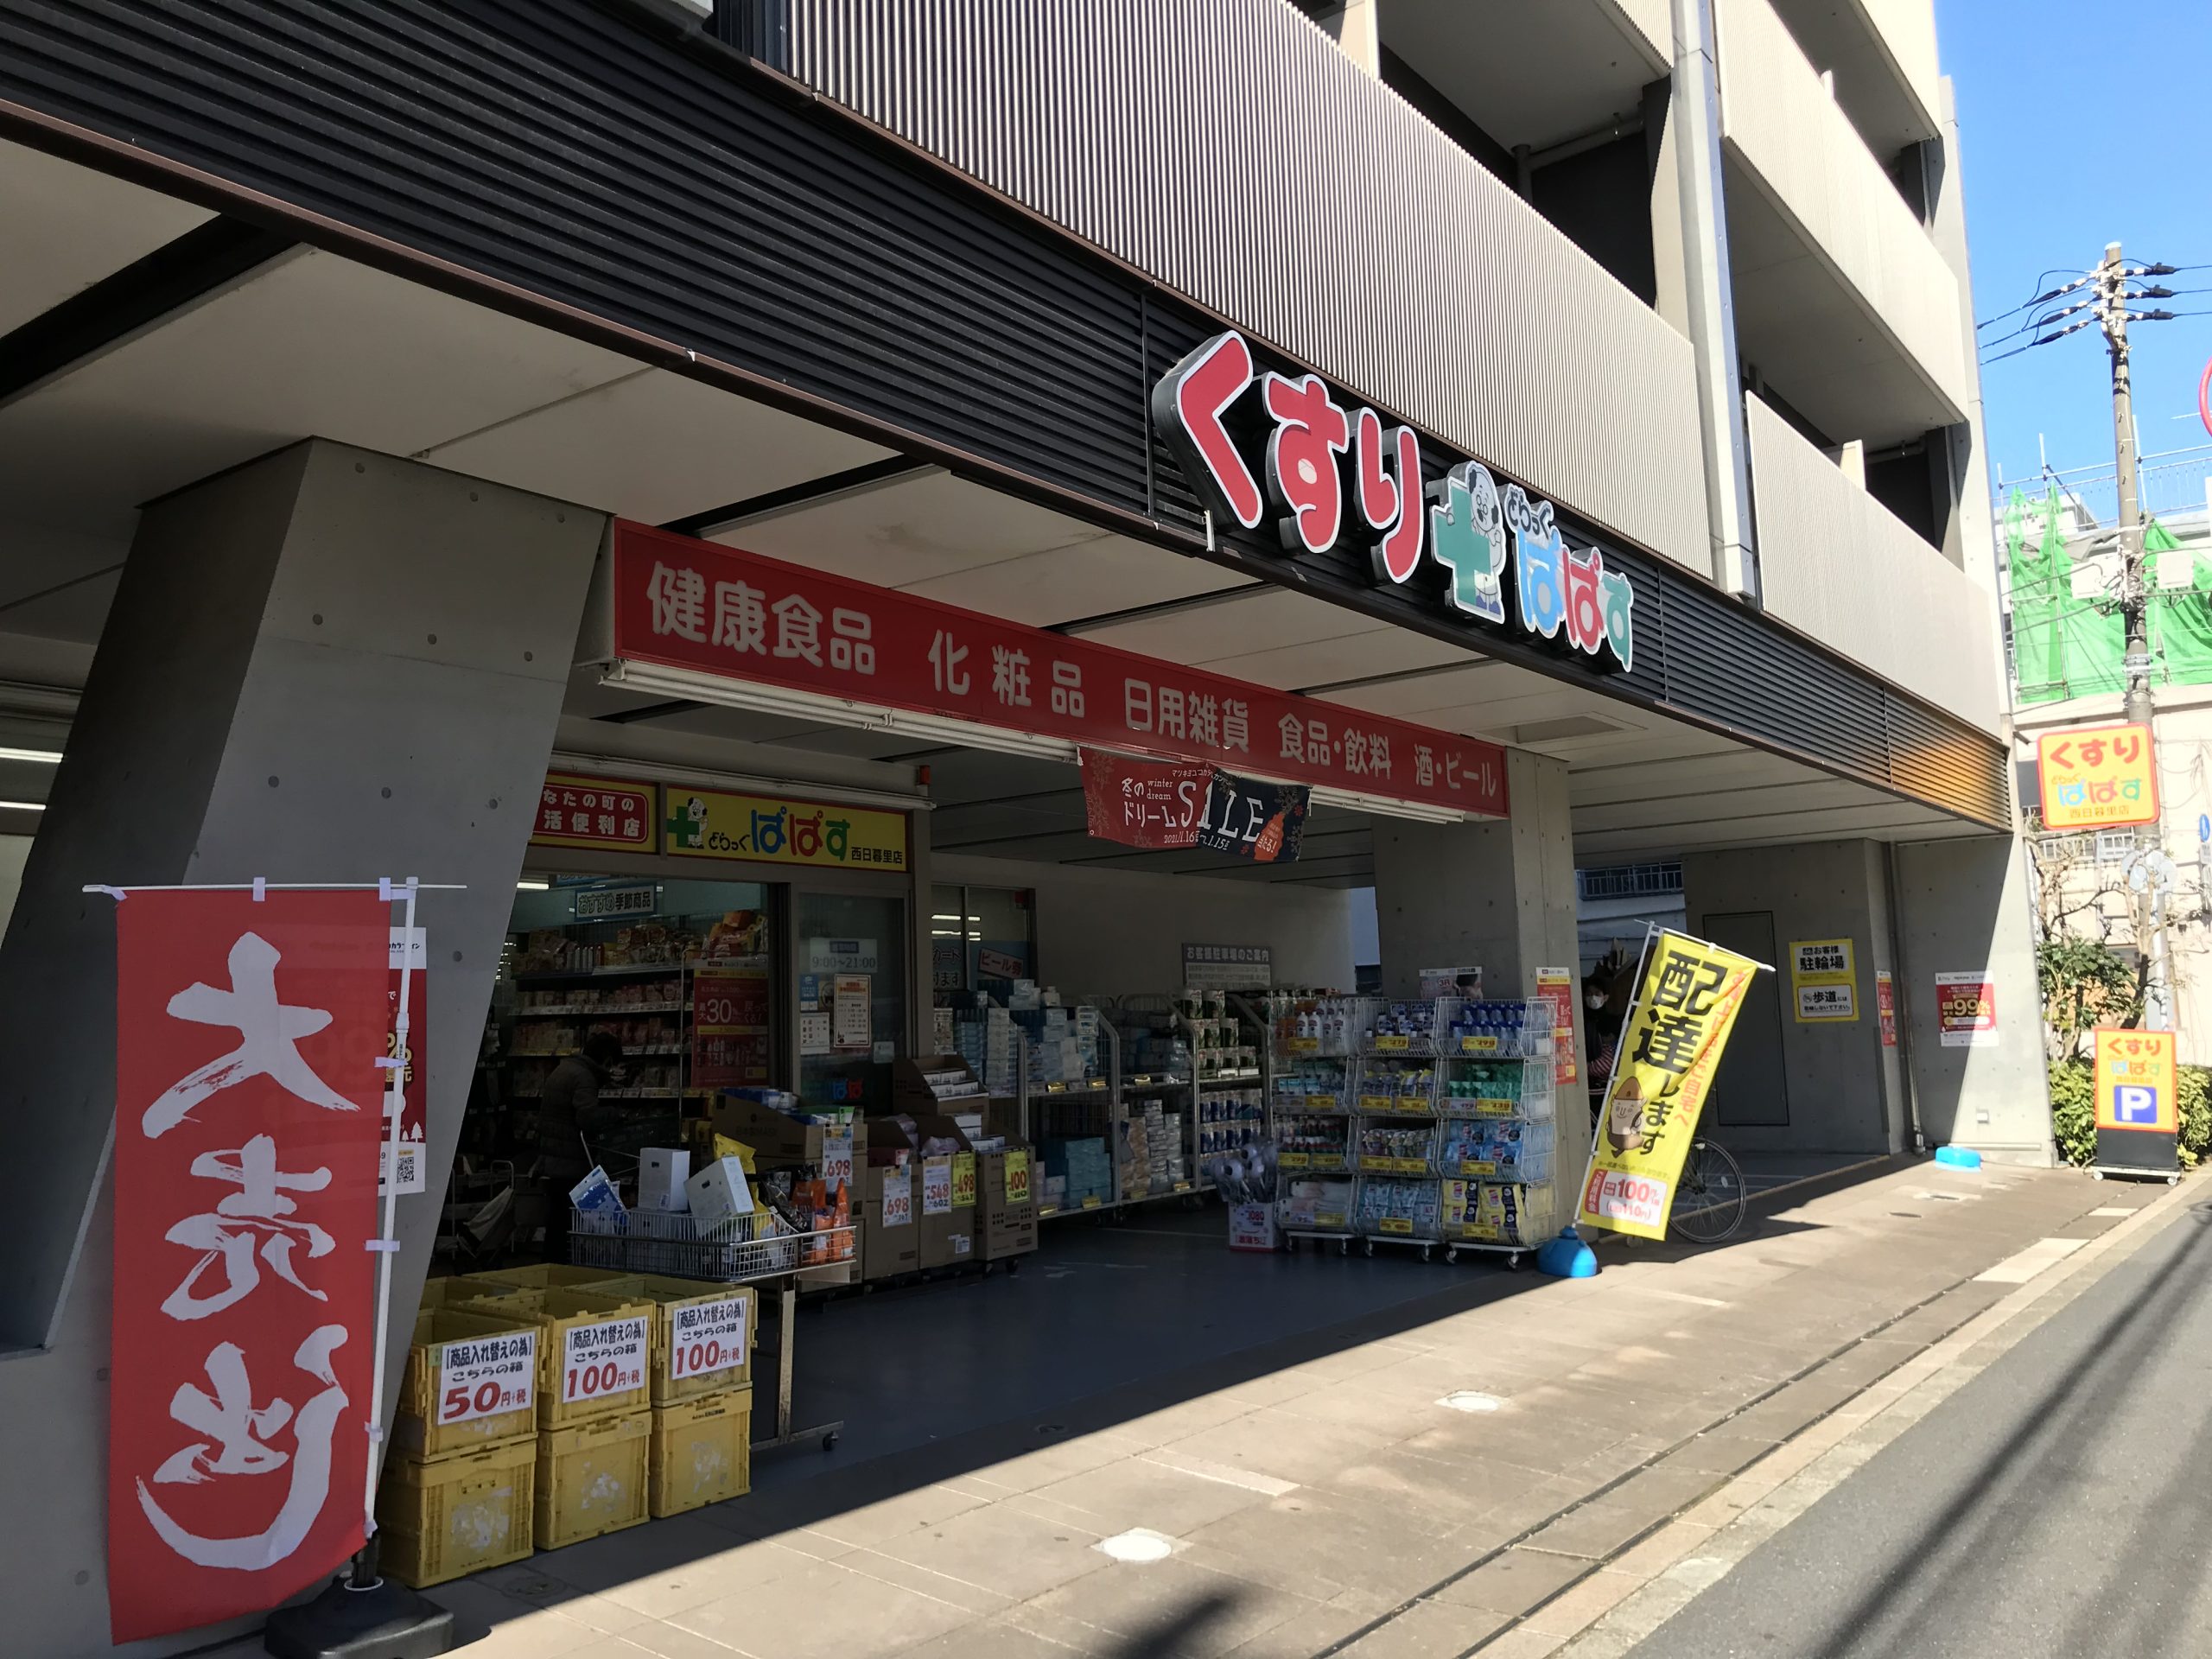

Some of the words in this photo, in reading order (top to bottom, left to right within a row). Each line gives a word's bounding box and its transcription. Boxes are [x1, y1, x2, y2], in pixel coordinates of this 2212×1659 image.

[1177, 330, 1424, 583] くすり
[1507, 486, 1554, 537] どらっく
[1516, 529, 1633, 672] ぱぱす
[646, 560, 876, 676] 健康食品
[927, 629, 1086, 719] 化粧品
[1123, 677, 1250, 754] 日用雑貨
[1278, 712, 1393, 780] 食品・飲料
[1414, 742, 1497, 798] 酒・ビール
[2050, 734, 2140, 770] くすり
[1122, 777, 1144, 798] 冬の
[1147, 779, 1173, 788] winter
[1147, 788, 1172, 800] dream
[2058, 775, 2143, 806] ぱぱす
[1124, 801, 1177, 828] ドリーム
[2069, 805, 2130, 819] 西日暮里店
[709, 832, 750, 851] どらっく
[751, 806, 851, 861] ぱぱす
[851, 847, 902, 864] 西日暮里店
[578, 892, 651, 914] おすすめ季節商品
[981, 952, 1023, 976] ビール券
[1800, 956, 1844, 971] 駐輪場
[707, 999, 732, 1023] 30
[1632, 950, 1728, 1155] 配達します
[2107, 1037, 2161, 1056] くすり
[2121, 1087, 2152, 1122] P
[827, 1160, 850, 1177] 698
[931, 1183, 949, 1200] 548
[958, 1173, 975, 1192] 498
[1010, 1170, 1027, 1192] 100
[887, 1197, 909, 1216] 698
[682, 1322, 737, 1341] こちらの箱
[575, 1344, 638, 1363] こちらの箱
[452, 1361, 524, 1382] こちらの箱
